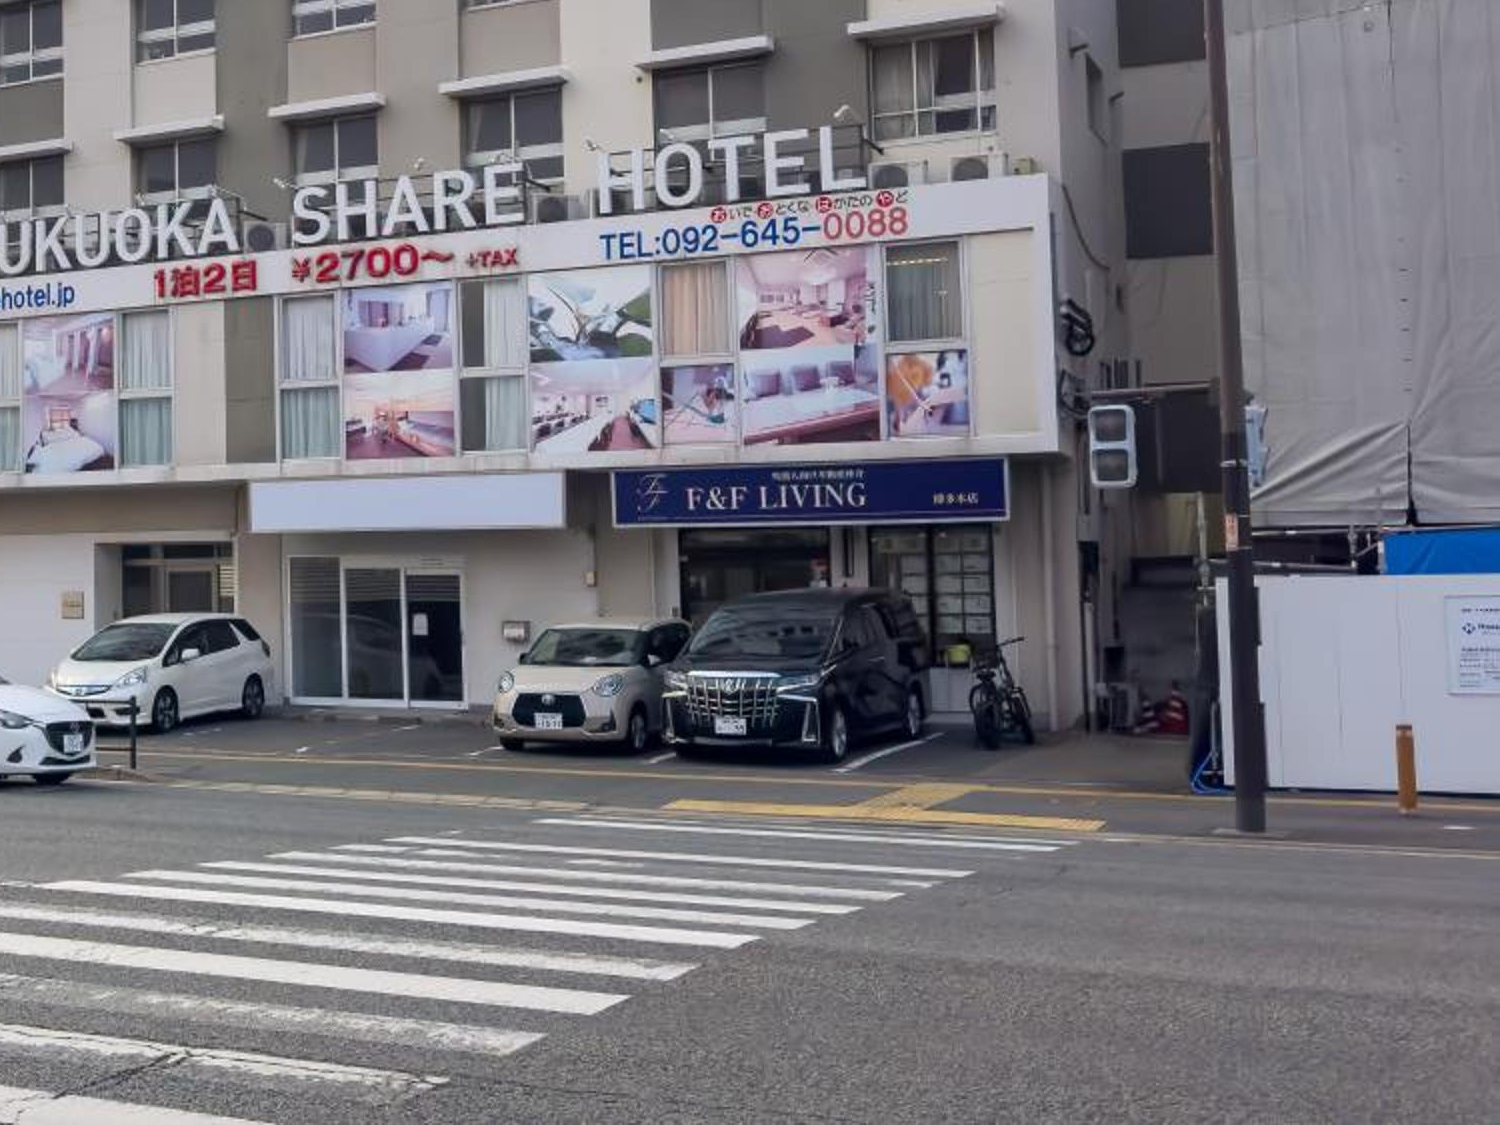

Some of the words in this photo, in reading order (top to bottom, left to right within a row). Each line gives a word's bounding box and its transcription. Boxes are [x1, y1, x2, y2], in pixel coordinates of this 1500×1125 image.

[292, 162, 524, 245] SHARE
[599, 126, 868, 214] HOTEL
[153, 260, 258, 298] 1泊2日
[686, 486, 748, 511] F&F
[759, 482, 868, 510] LIVING
